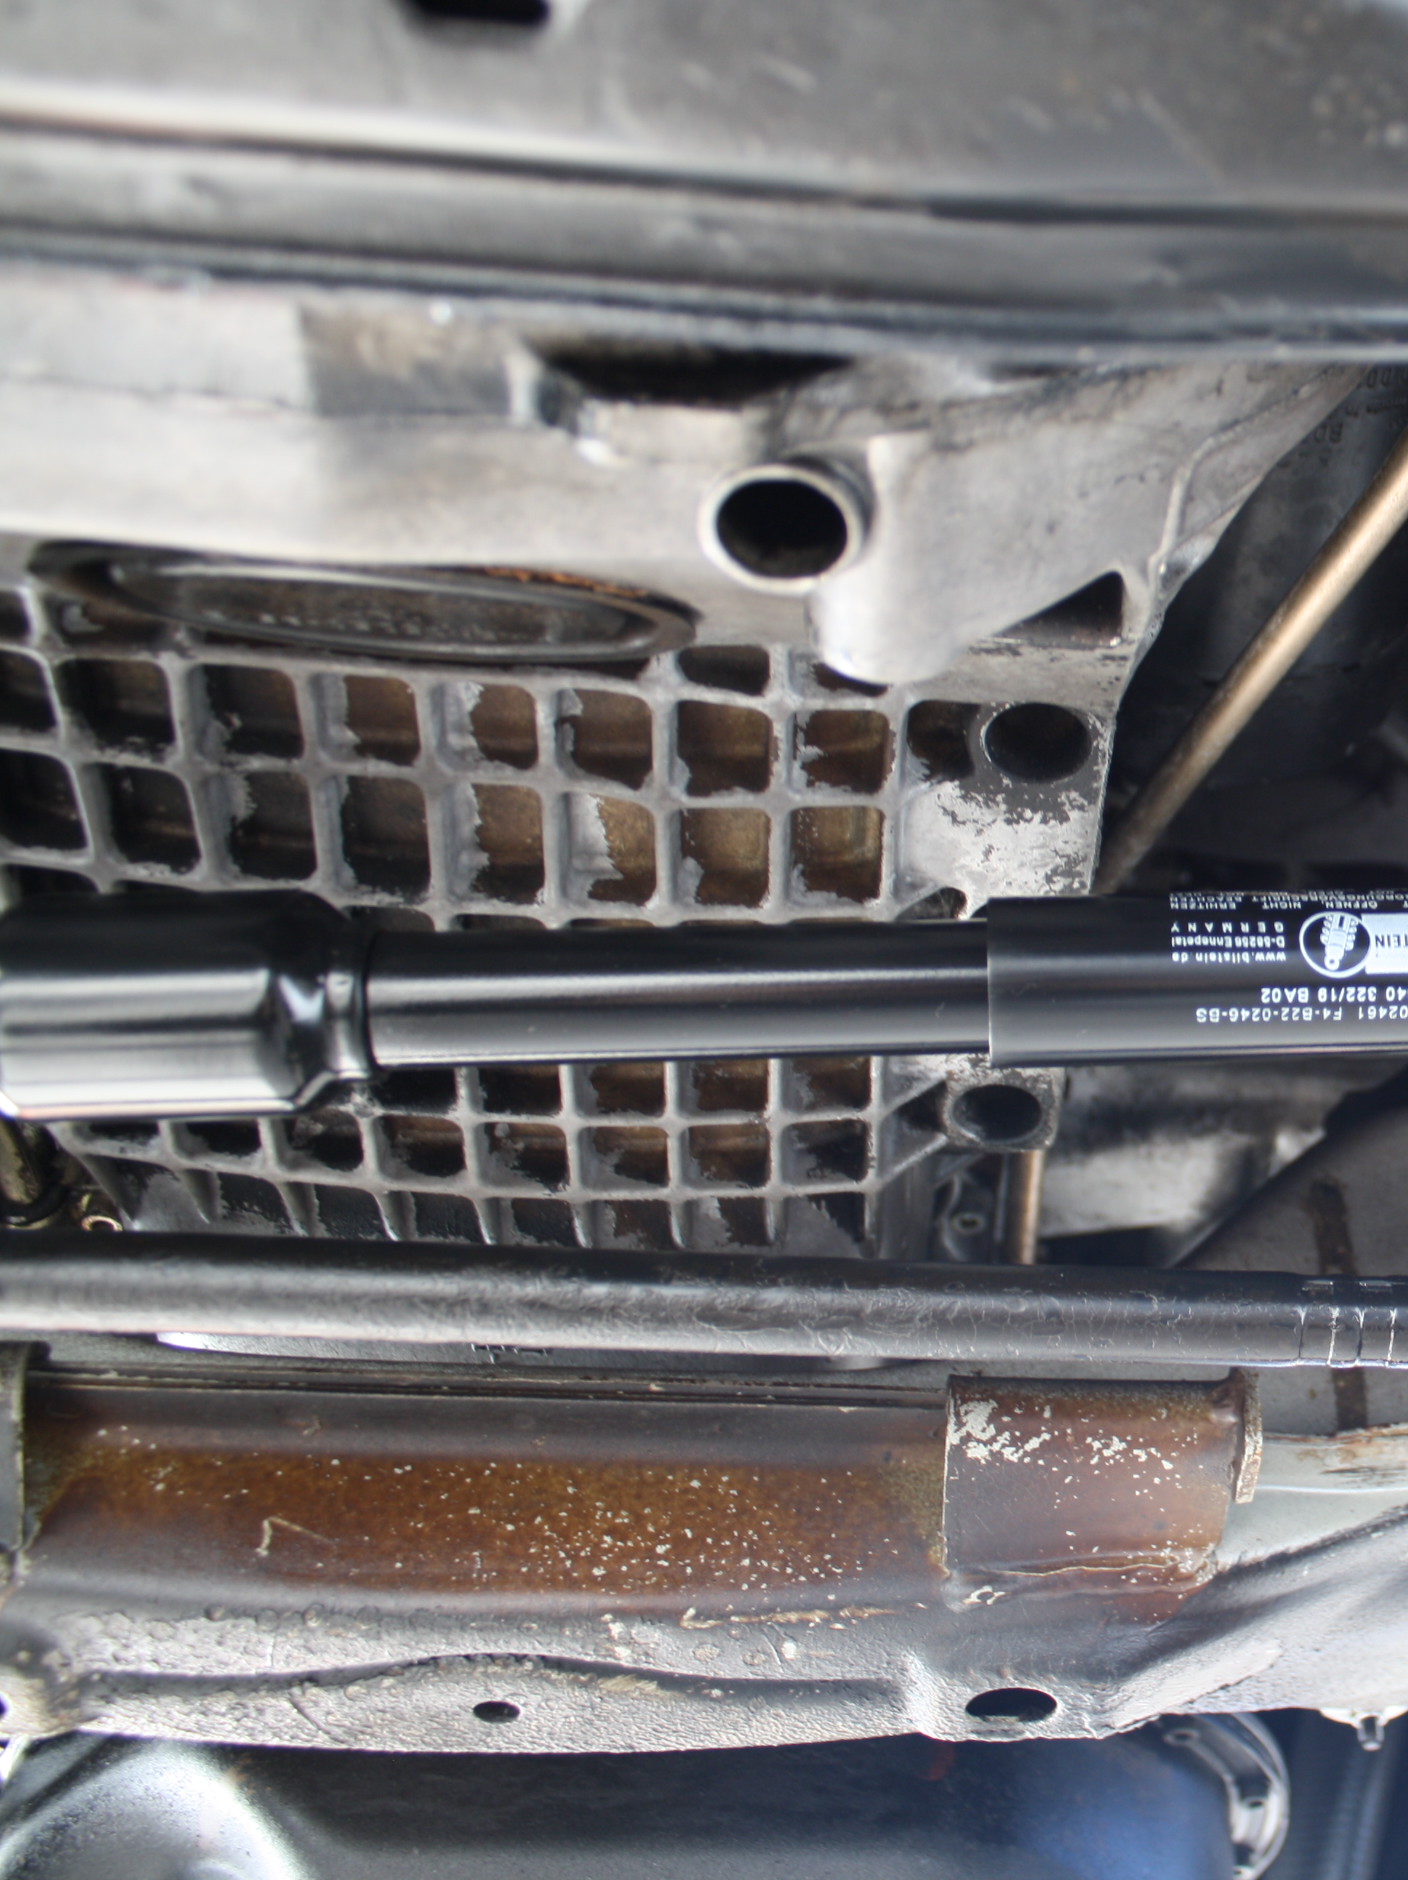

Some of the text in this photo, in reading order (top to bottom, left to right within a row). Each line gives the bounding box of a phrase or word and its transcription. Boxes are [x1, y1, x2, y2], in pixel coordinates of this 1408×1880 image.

[1169, 901, 1237, 910] ERHITZEN
[1170, 921, 1285, 933] GERMANY
[1171, 935, 1233, 948] Ennepetal
[1260, 986, 1309, 1004] BA02
[1195, 1006, 1343, 1023] F4-B22-0246-BS
